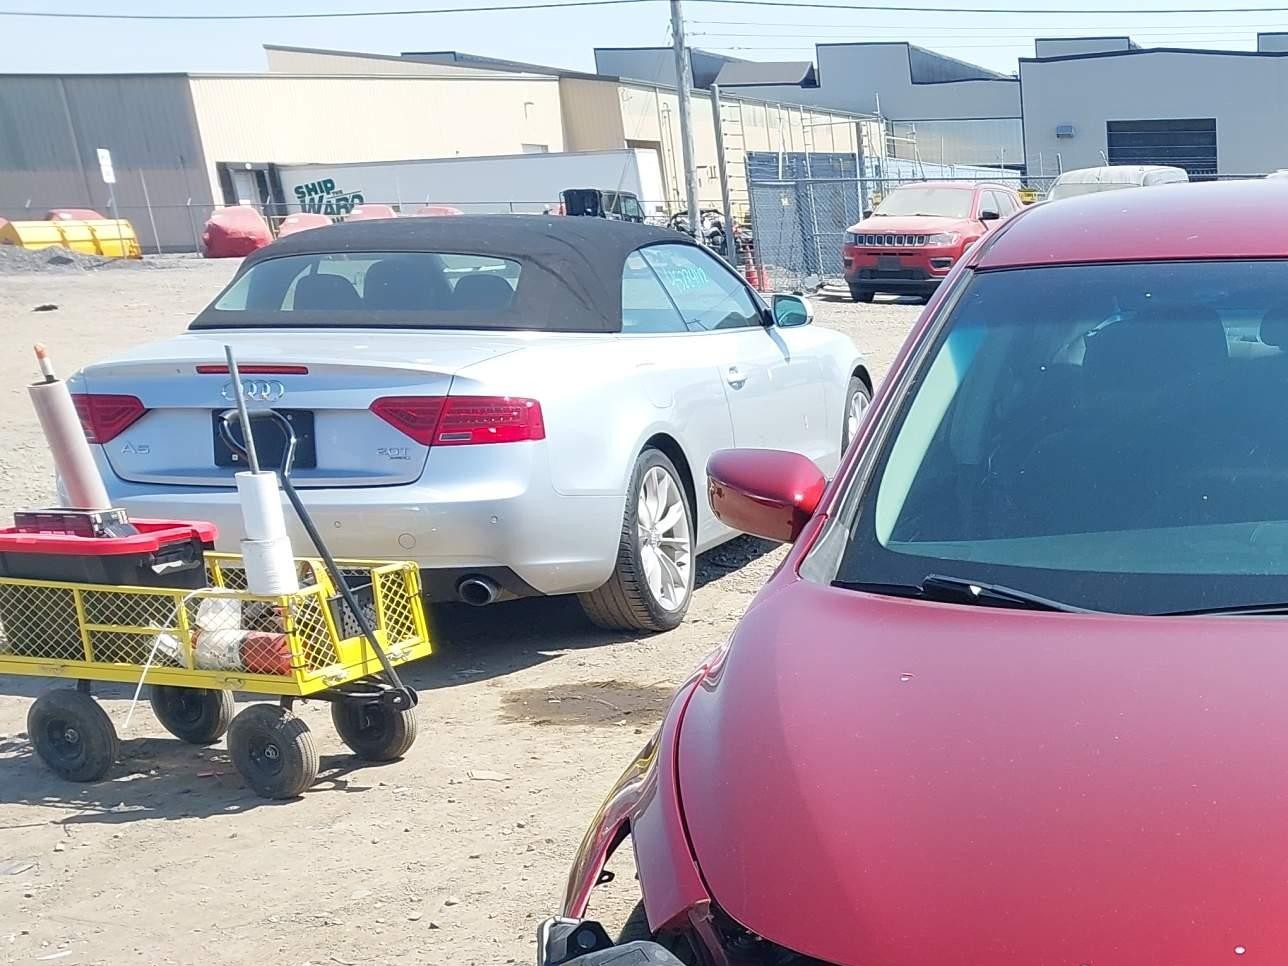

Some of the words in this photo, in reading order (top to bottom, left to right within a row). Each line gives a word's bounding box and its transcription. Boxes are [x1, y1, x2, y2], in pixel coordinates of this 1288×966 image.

[294, 178, 335, 199] SHIP
[299, 193, 365, 216] WARD
[121, 440, 151, 455] A5
